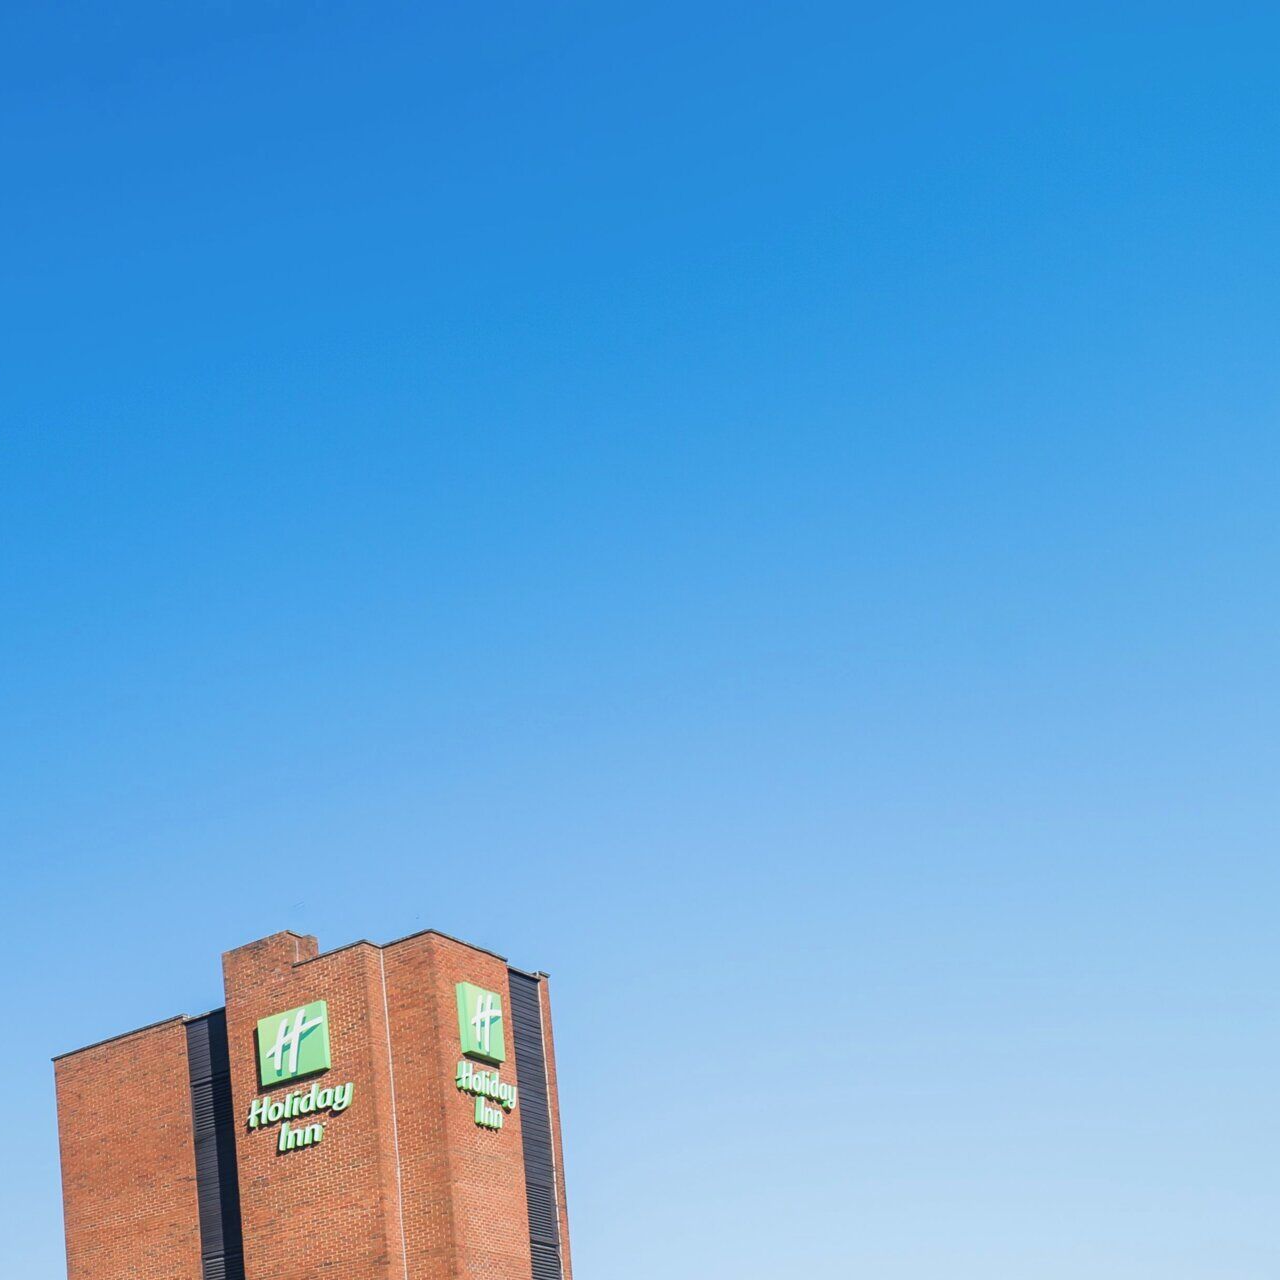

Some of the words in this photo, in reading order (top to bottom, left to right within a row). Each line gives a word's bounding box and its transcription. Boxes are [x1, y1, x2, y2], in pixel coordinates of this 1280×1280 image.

[456, 1061, 517, 1108] Holiday
[247, 1082, 354, 1128] Holiday
[475, 1097, 503, 1129] Inn
[277, 1121, 325, 1151] Inn
